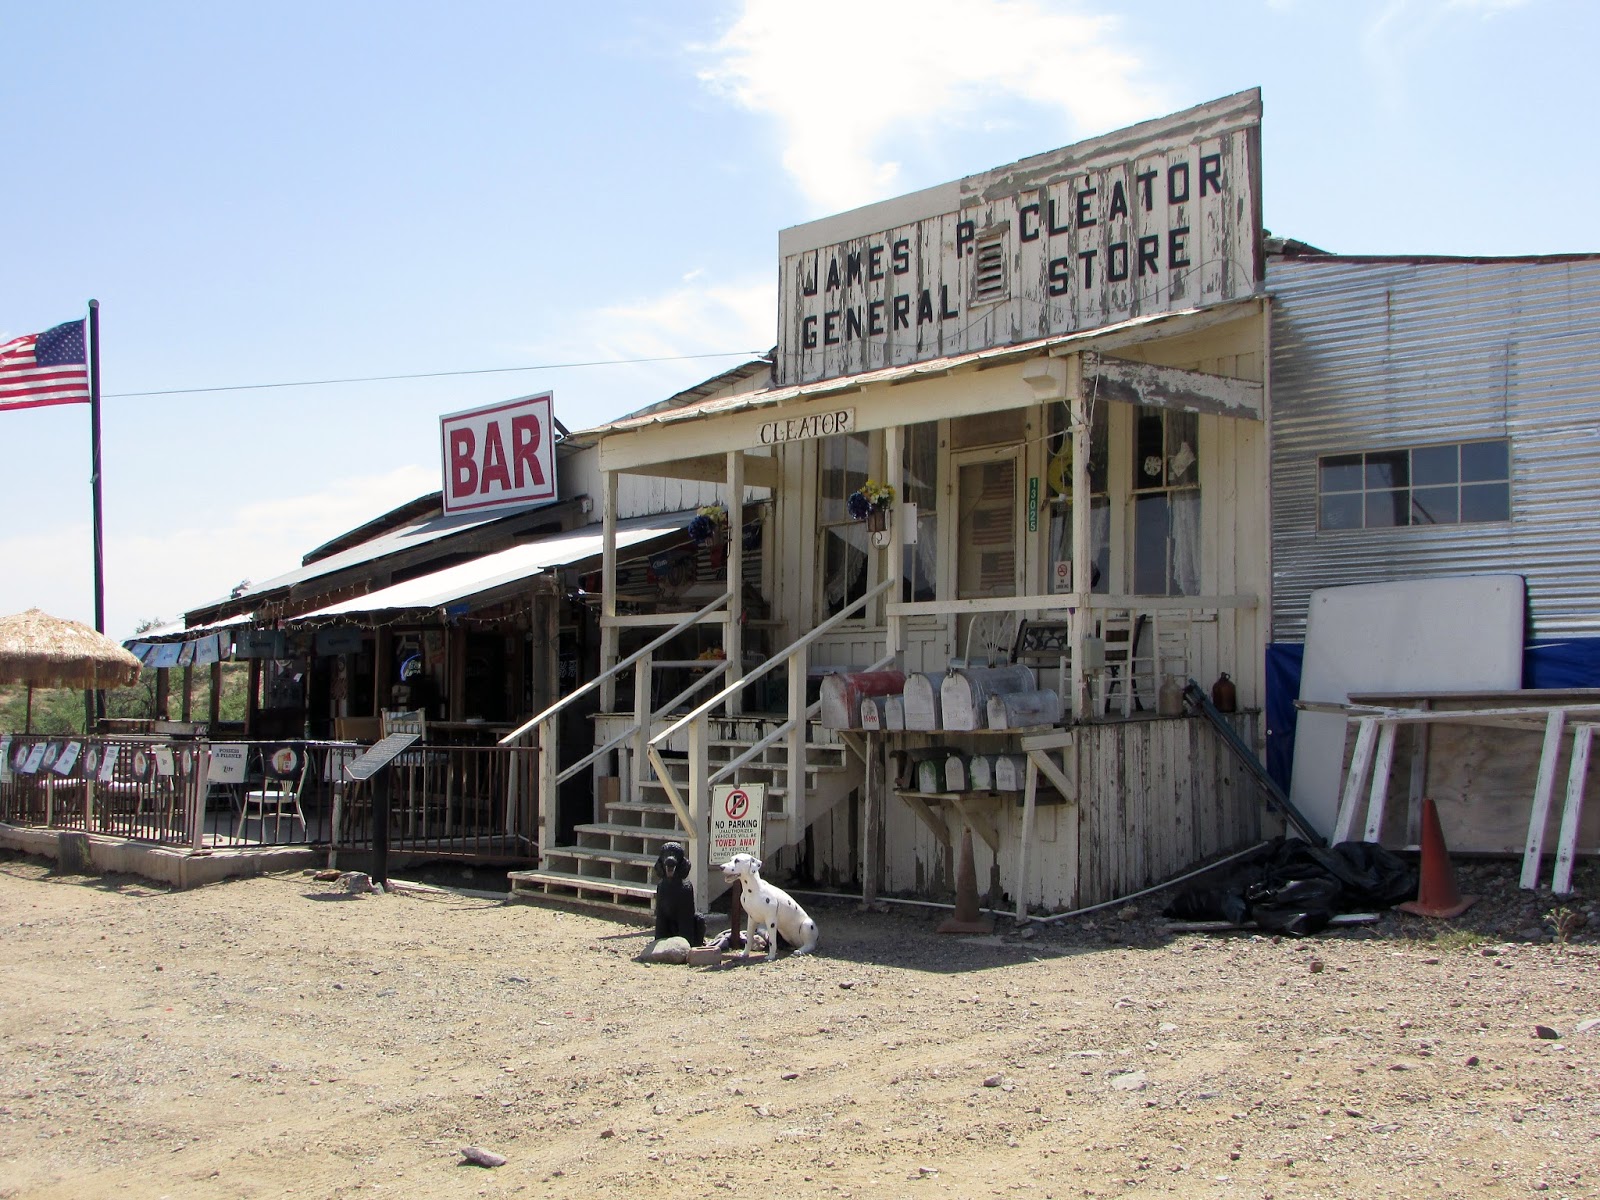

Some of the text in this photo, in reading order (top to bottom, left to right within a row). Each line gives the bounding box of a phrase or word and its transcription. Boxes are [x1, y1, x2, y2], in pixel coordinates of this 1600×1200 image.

[803, 154, 1222, 296] JAMES P. CLEATOR
[803, 227, 1190, 349] GENERAL STORE
[450, 414, 545, 498] BAR
[760, 411, 849, 444] CLEATOR
[715, 820, 758, 829] NO PARKING
[715, 839, 756, 847] TOWED AWAY
